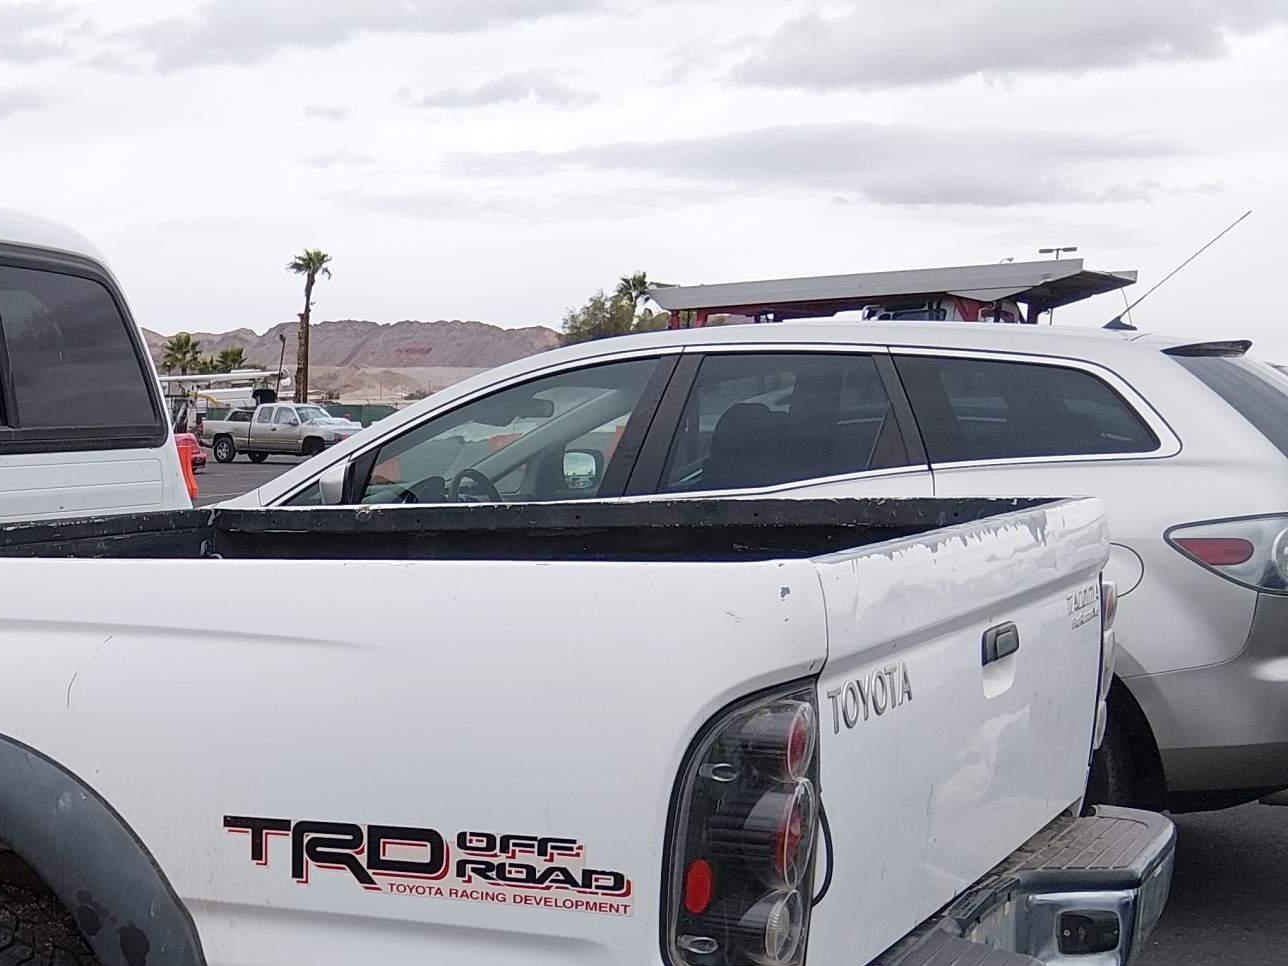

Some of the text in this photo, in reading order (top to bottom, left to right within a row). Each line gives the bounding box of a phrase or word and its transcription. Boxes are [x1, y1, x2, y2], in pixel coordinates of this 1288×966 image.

[826, 659, 913, 735] TOYOTA
[223, 814, 450, 891] TRD
[456, 831, 583, 862] OFF
[455, 859, 632, 897] ROAD
[387, 882, 631, 914] TOYOTA RACING DEVELOPMENT
